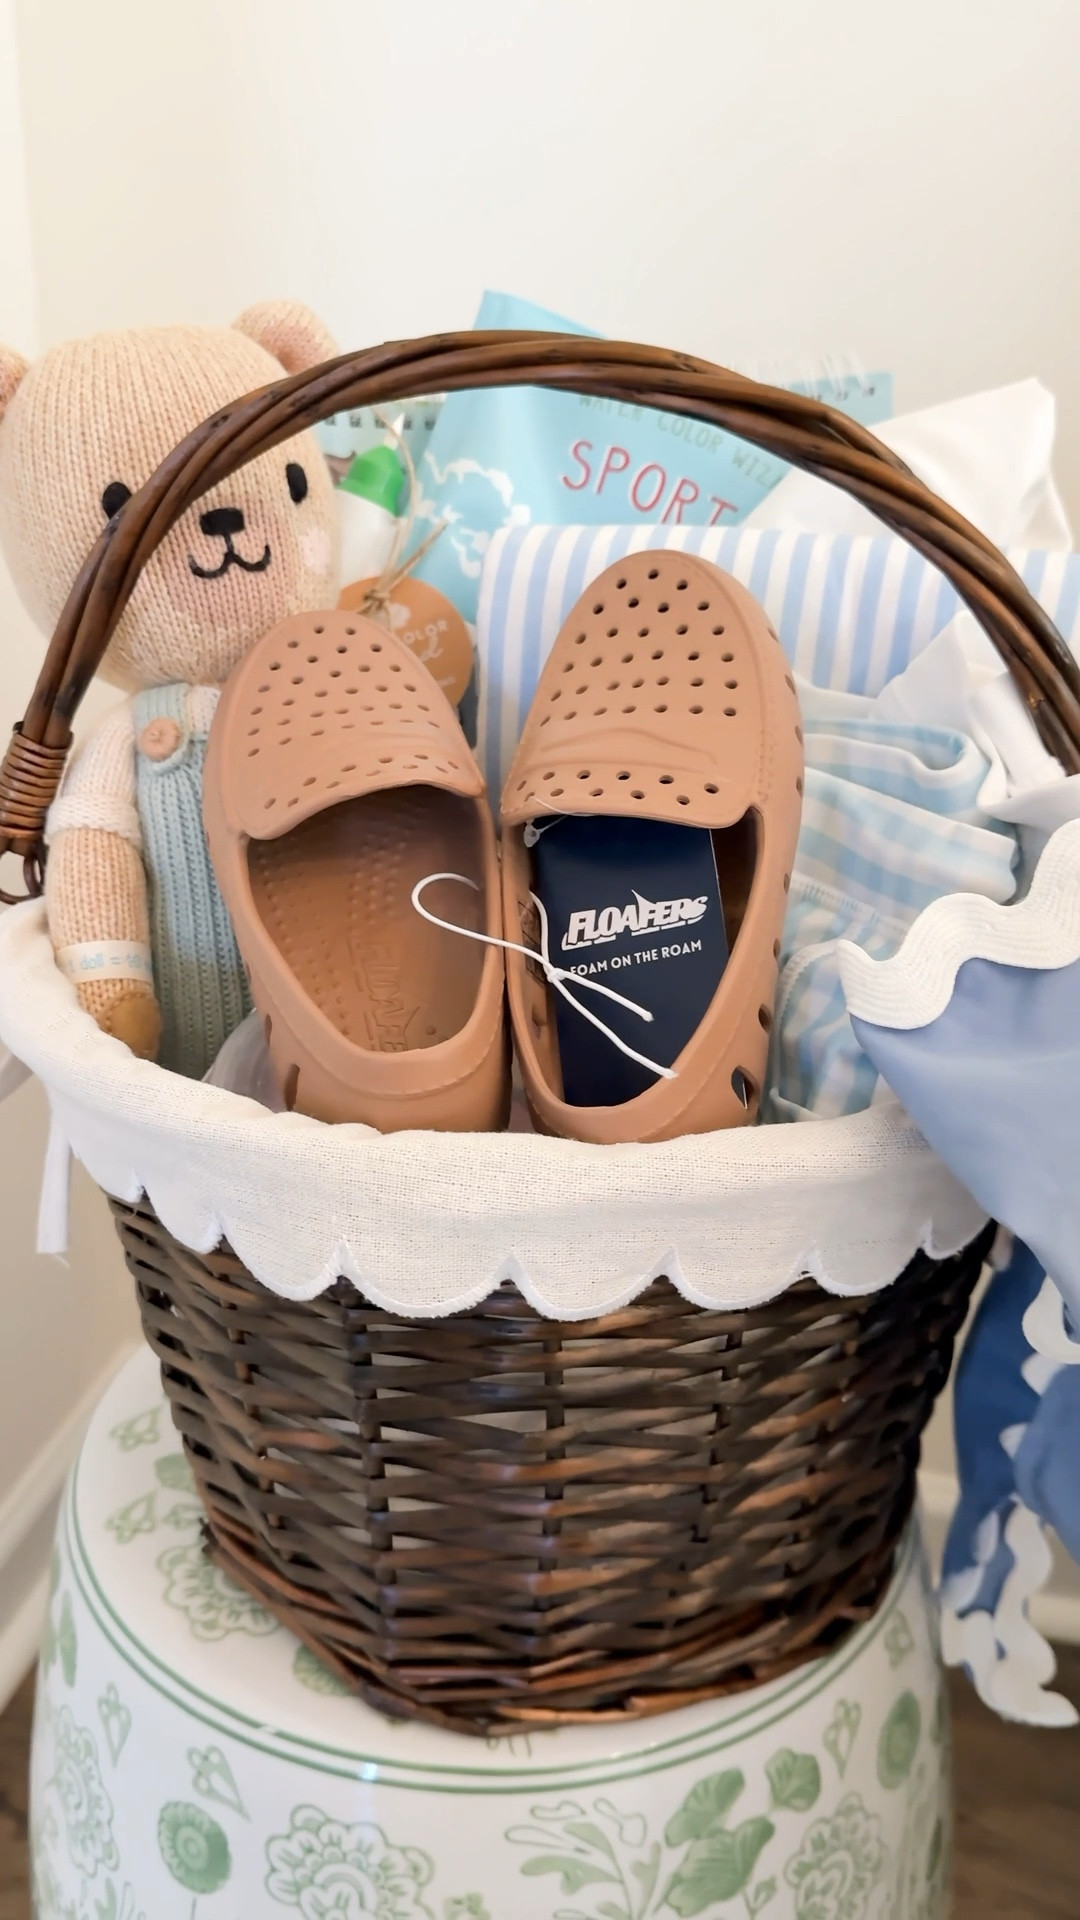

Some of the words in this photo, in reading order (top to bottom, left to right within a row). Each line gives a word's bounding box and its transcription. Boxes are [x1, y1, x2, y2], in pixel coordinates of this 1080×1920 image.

[657, 411, 724, 455] COLOR
[562, 439, 739, 525] SPORT
[562, 890, 709, 949] FLOAFERS
[570, 960, 608, 976] FOAM
[611, 954, 632, 970] ON
[634, 948, 659, 964] THE
[661, 939, 702, 959] ROAM
